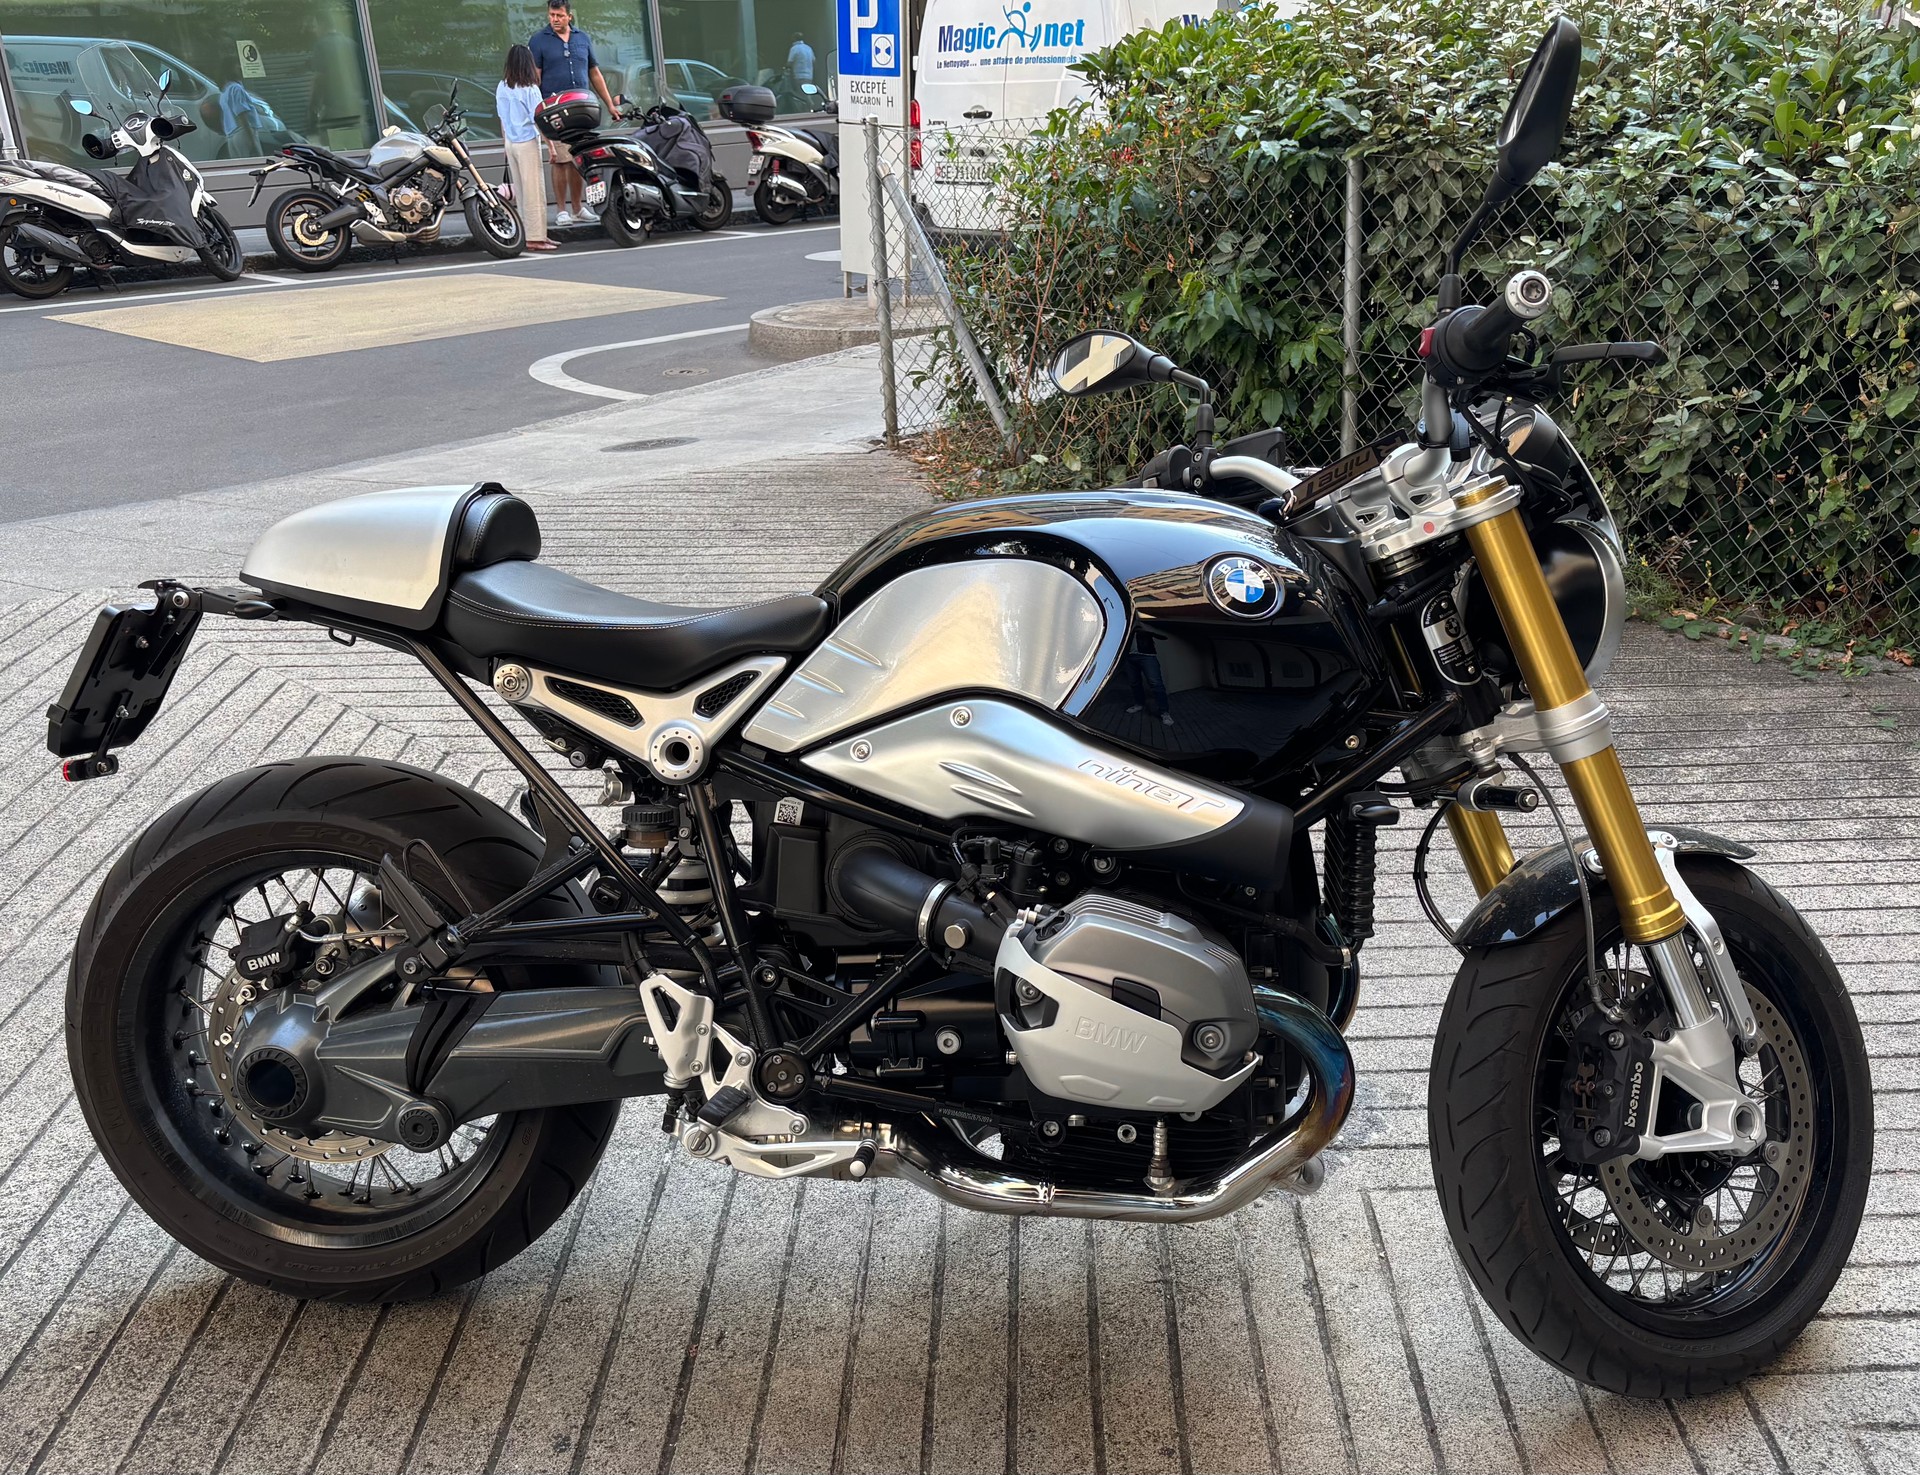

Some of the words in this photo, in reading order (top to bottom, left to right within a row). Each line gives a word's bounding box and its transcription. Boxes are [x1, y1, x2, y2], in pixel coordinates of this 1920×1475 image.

[849, 0, 879, 54] P
[938, 22, 996, 53] Magic
[1044, 19, 1085, 47] net
[980, 58, 991, 66] une
[992, 56, 1014, 66] affaire
[1015, 56, 1024, 64] de
[850, 79, 887, 95] EXCEPTÉ
[850, 95, 882, 106] MACARON
[886, 96, 894, 108] H
[1218, 560, 1272, 582] BMW
[1078, 759, 1226, 814] nineT
[247, 952, 280, 971] BMW
[1074, 1016, 1148, 1054] BMW
[1624, 1061, 1644, 1128] brembo
